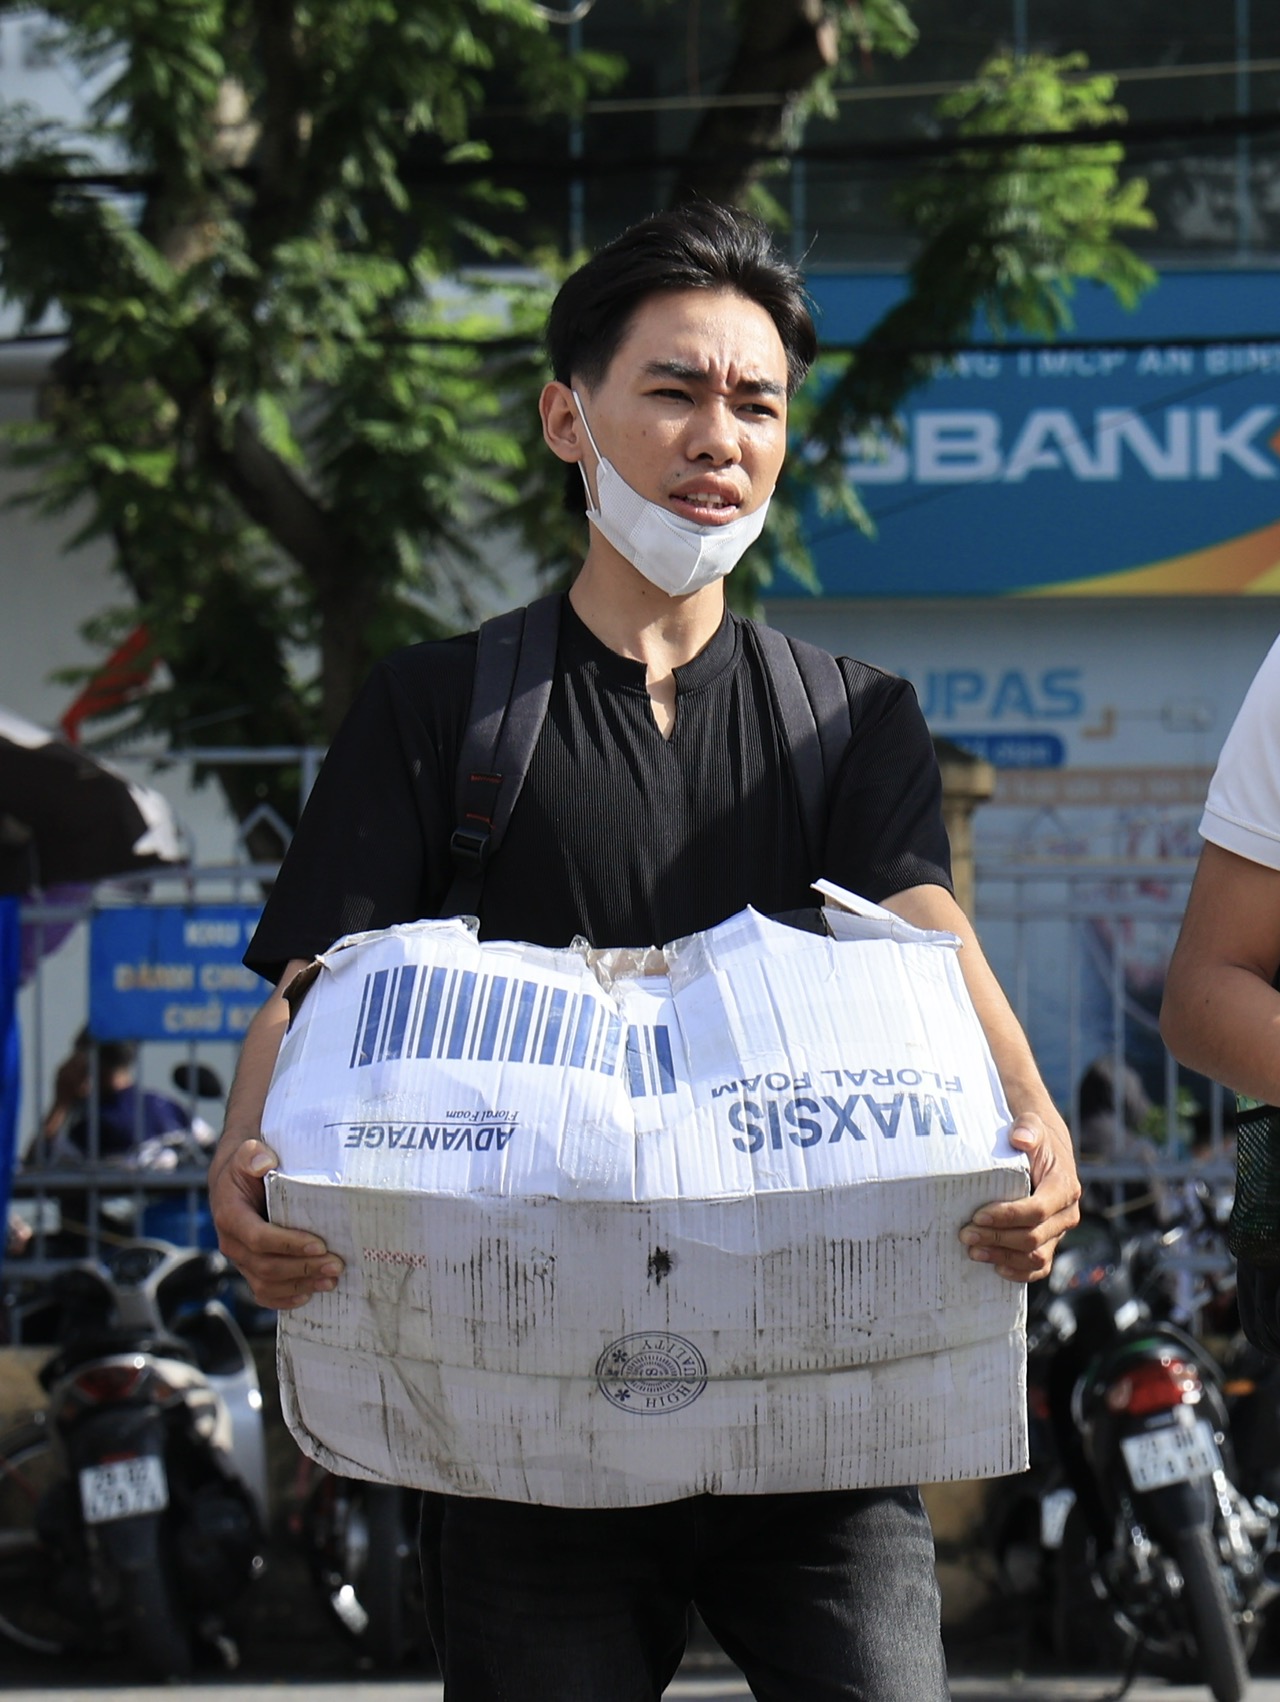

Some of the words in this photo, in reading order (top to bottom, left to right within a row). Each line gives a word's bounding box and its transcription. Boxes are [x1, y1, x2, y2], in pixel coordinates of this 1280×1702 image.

[711, 1071, 813, 1098] FOAM
[820, 1068, 964, 1093] FLORAL
[445, 1111, 480, 1122] Foam
[481, 1110, 520, 1122] Floral
[728, 1093, 959, 1154] MAXSIS
[344, 1126, 517, 1151] ADVANTAGE
[645, 1385, 692, 1408] HIGH
